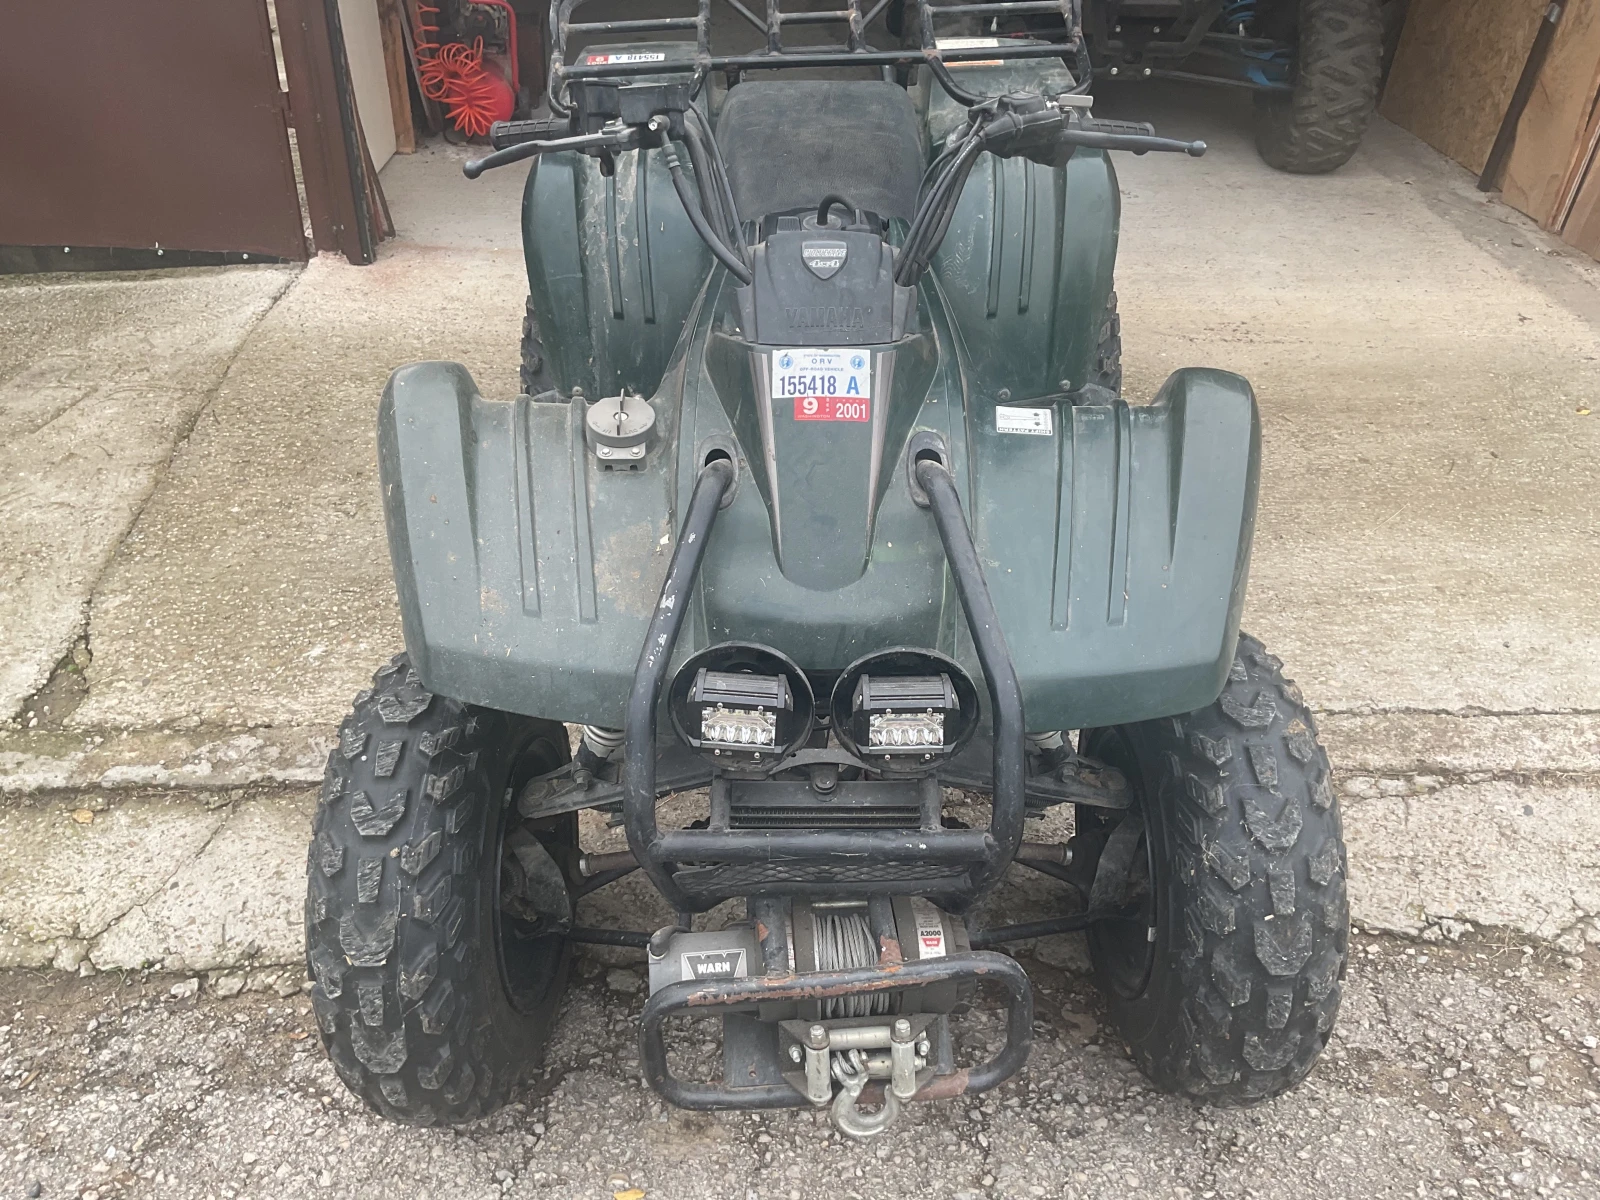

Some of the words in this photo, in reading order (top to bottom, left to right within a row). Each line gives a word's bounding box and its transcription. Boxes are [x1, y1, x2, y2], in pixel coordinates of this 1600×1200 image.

[809, 259, 839, 268] 4x4
[785, 306, 864, 328] YAMAHA
[779, 375, 837, 396] 155418
[846, 375, 860, 395] A
[802, 397, 819, 415] 9
[835, 403, 866, 419] 2001
[696, 961, 731, 974] WARN
